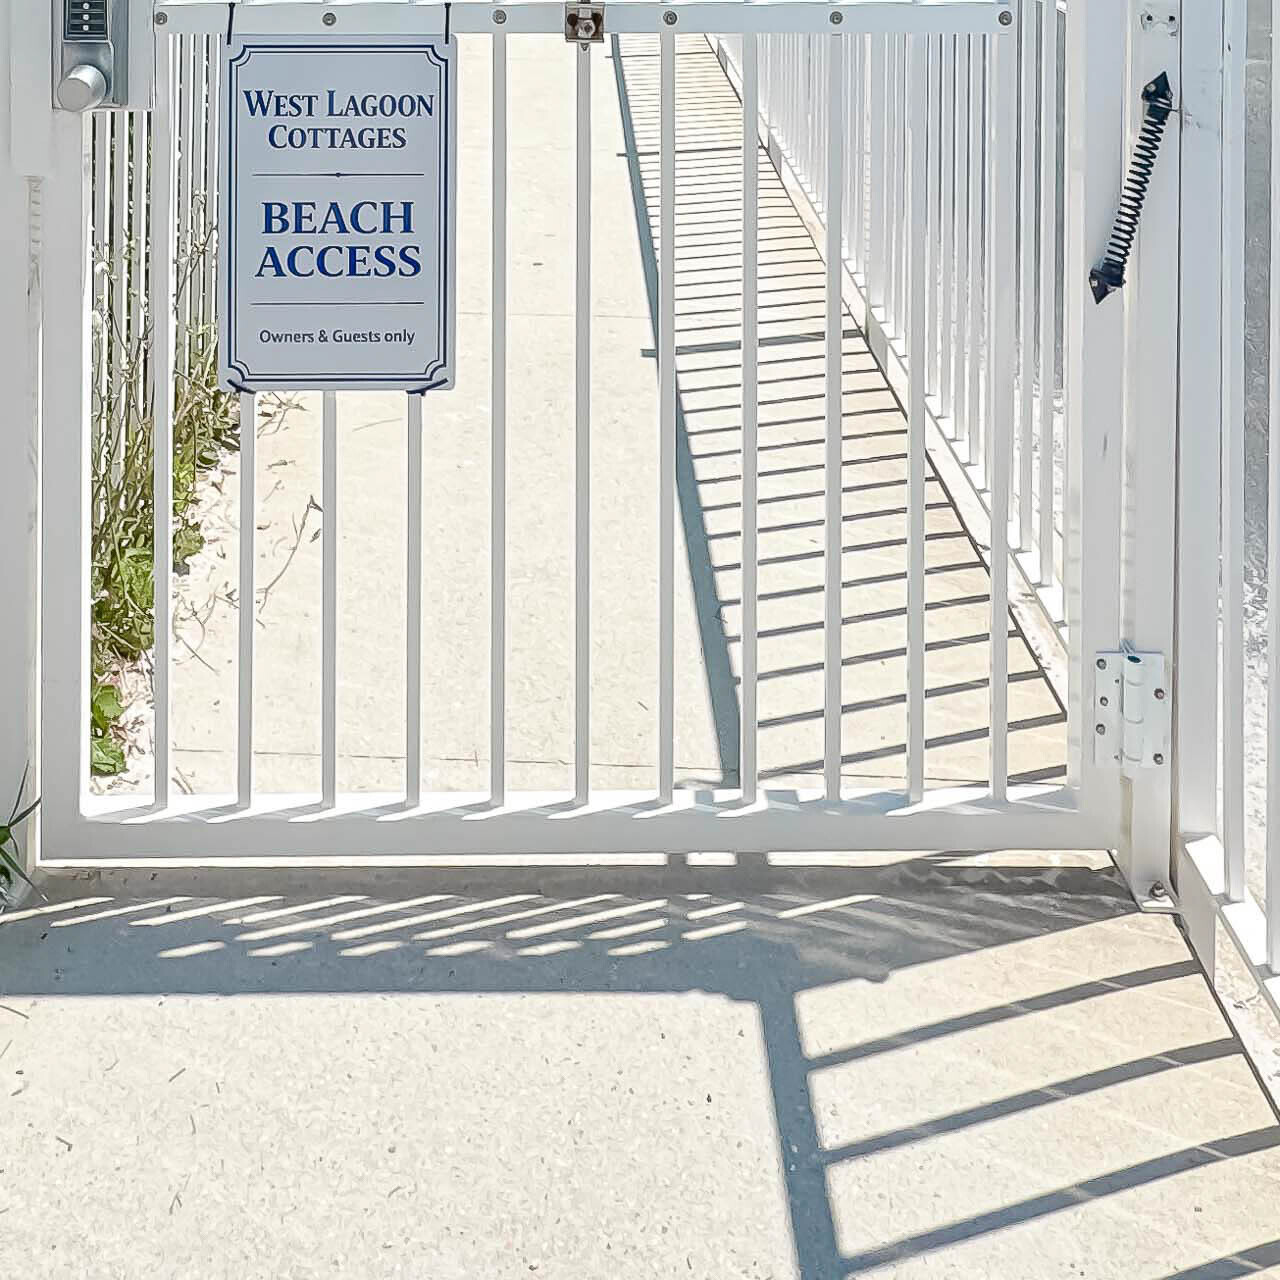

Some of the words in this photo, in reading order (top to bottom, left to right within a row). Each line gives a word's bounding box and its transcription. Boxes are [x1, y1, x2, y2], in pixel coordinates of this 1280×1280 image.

[242, 89, 319, 118] WEST
[326, 89, 435, 118] LAGOON
[267, 124, 407, 150] COTTAGES
[261, 200, 415, 235] BEACH
[254, 245, 422, 278] ACCESS
[259, 329, 315, 345] Owners
[318, 329, 330, 344] &
[332, 329, 381, 345] Guests
[384, 328, 416, 346] only
